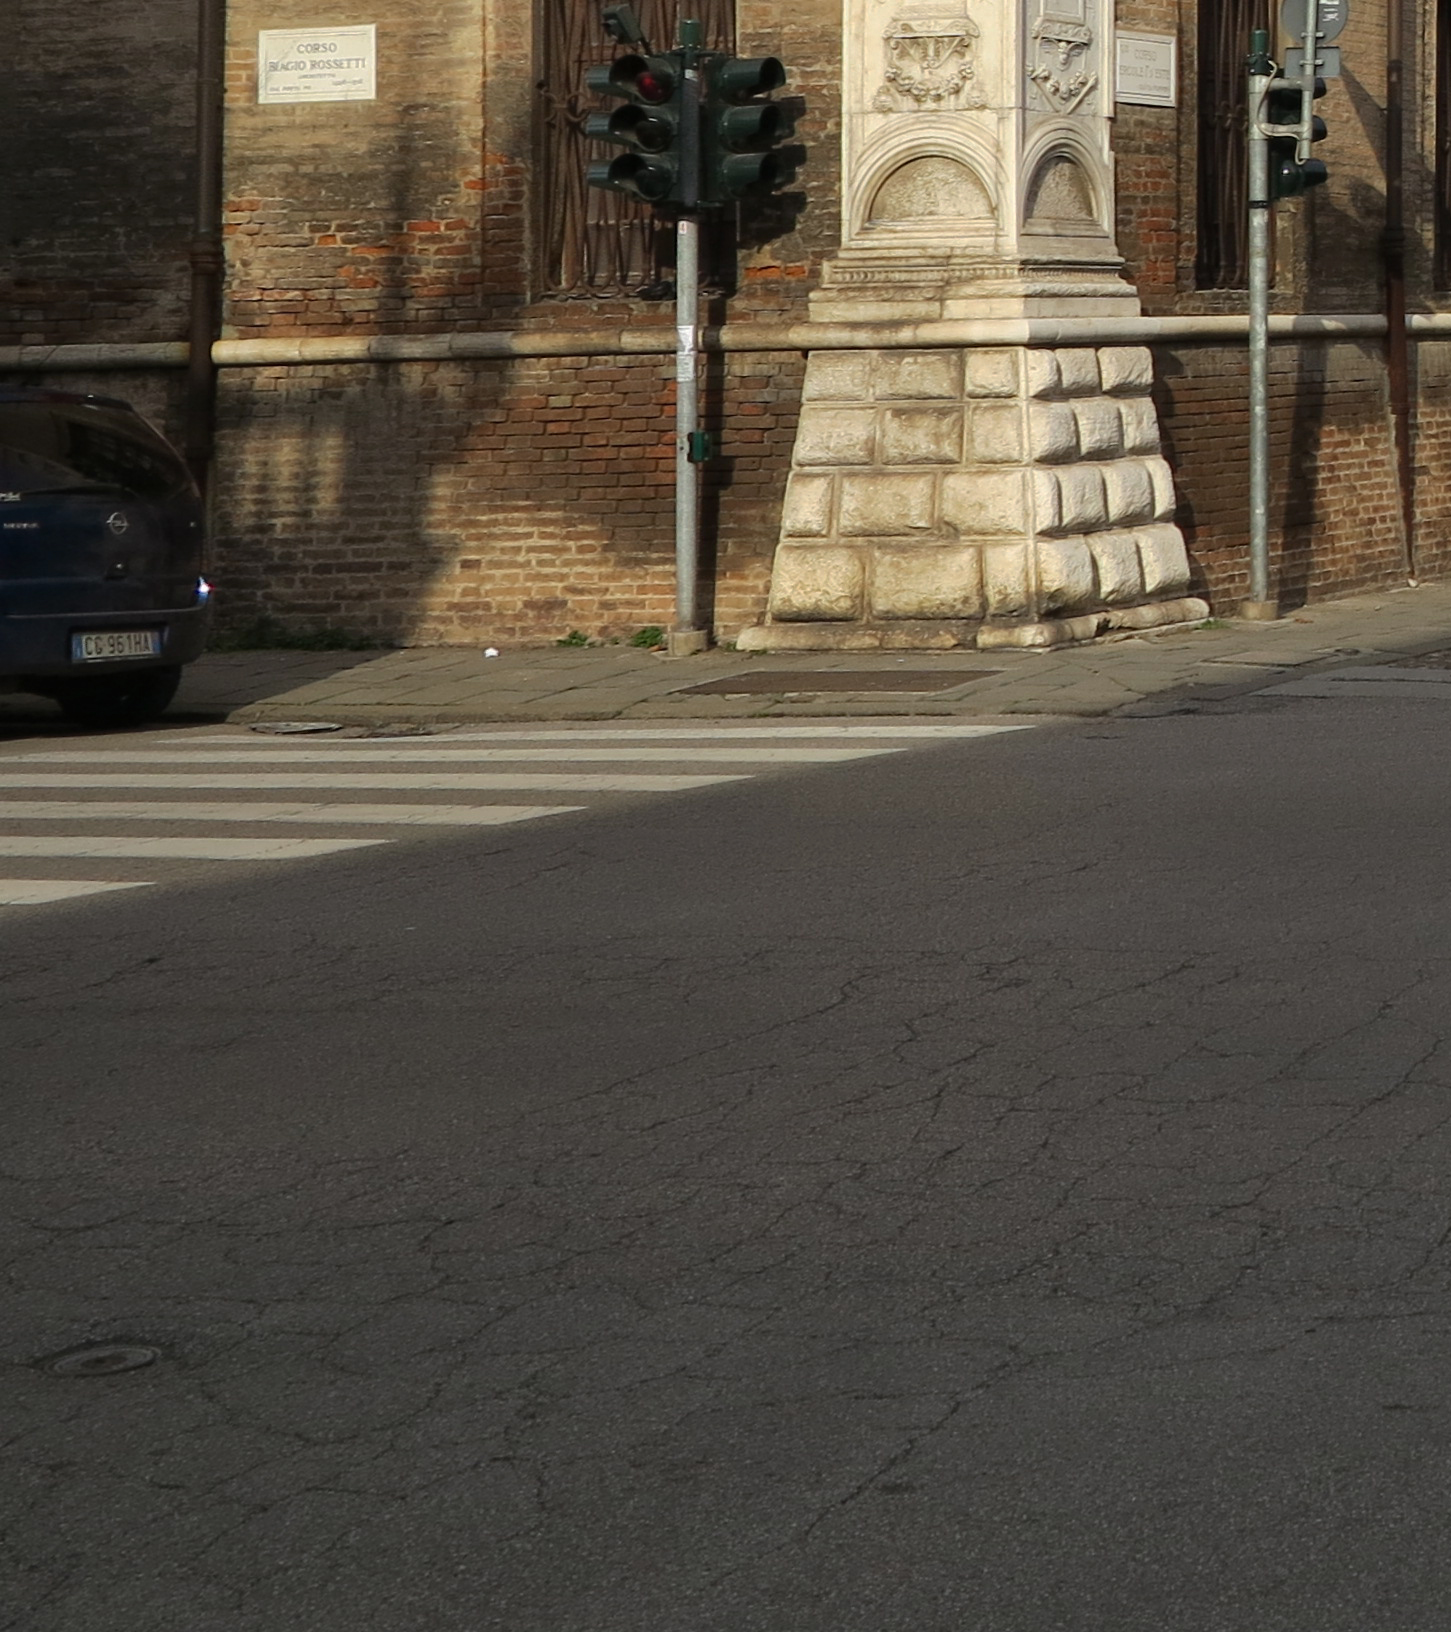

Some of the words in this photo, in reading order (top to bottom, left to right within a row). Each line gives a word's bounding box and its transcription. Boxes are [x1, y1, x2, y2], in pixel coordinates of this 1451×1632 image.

[296, 42, 338, 54] CORSO
[268, 60, 306, 72] BIAGIO
[310, 57, 366, 71] ROSSETTI
